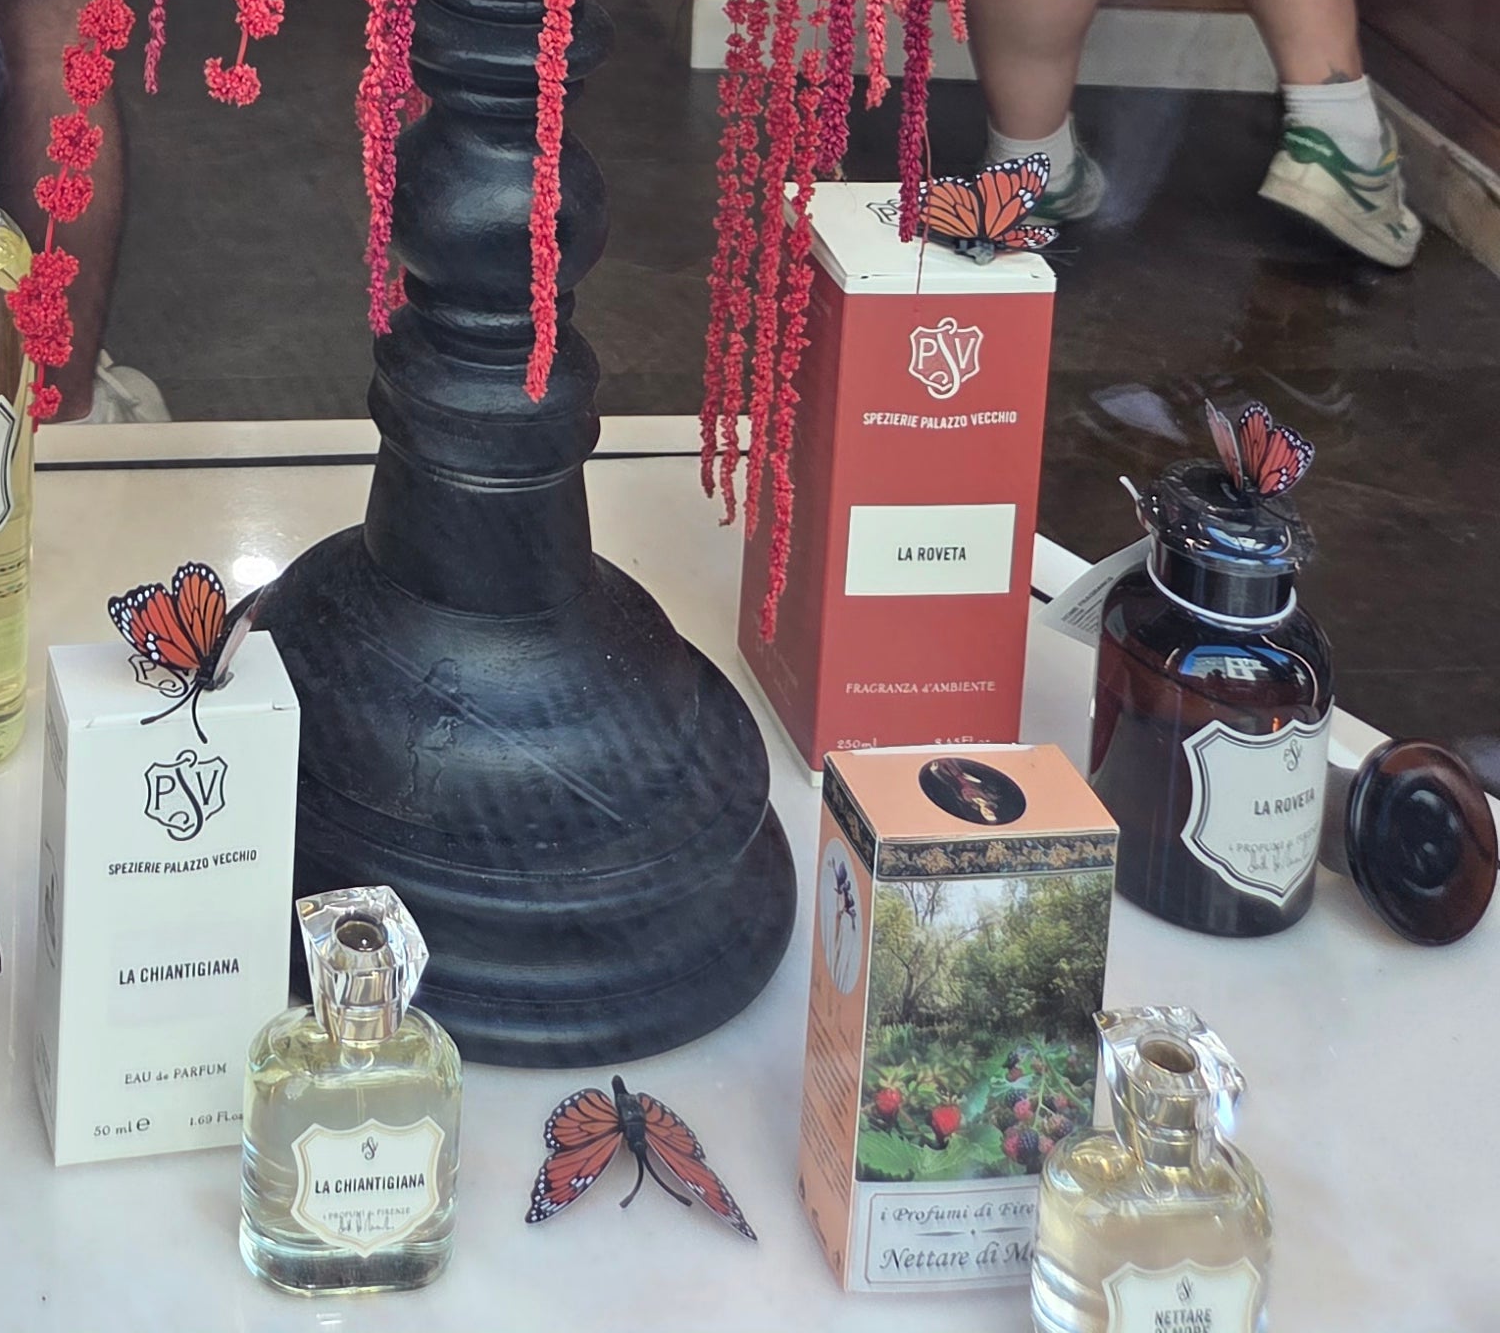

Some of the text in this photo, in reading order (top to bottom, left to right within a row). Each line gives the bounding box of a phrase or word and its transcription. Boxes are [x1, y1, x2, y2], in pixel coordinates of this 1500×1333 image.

[863, 410, 1017, 430] SPEZIERIE PALAZZO VECCHIO
[897, 546, 967, 562] LA ROVETA
[845, 680, 996, 694] FRAGRANZA d'AMBIENTE
[1253, 788, 1316, 817] LA ROVETA
[108, 849, 257, 876] SPEZIERIE PALAZZO VECCHIO
[119, 957, 240, 986] LA CHIANTIGIANA
[124, 1062, 227, 1085] EAU de PARFUM
[93, 1125, 111, 1137] 50
[189, 1114, 213, 1127] 1.69
[315, 1173, 425, 1195] LA CHIANTIGIANA
[377, 1207, 411, 1217] FIRENZE
[880, 1206, 889, 1222] i
[892, 1205, 969, 1225] Profumi
[974, 1202, 993, 1218] di
[879, 1246, 970, 1271] Nettare
[975, 1240, 998, 1266] di
[1154, 1308, 1212, 1326] NETTARE
